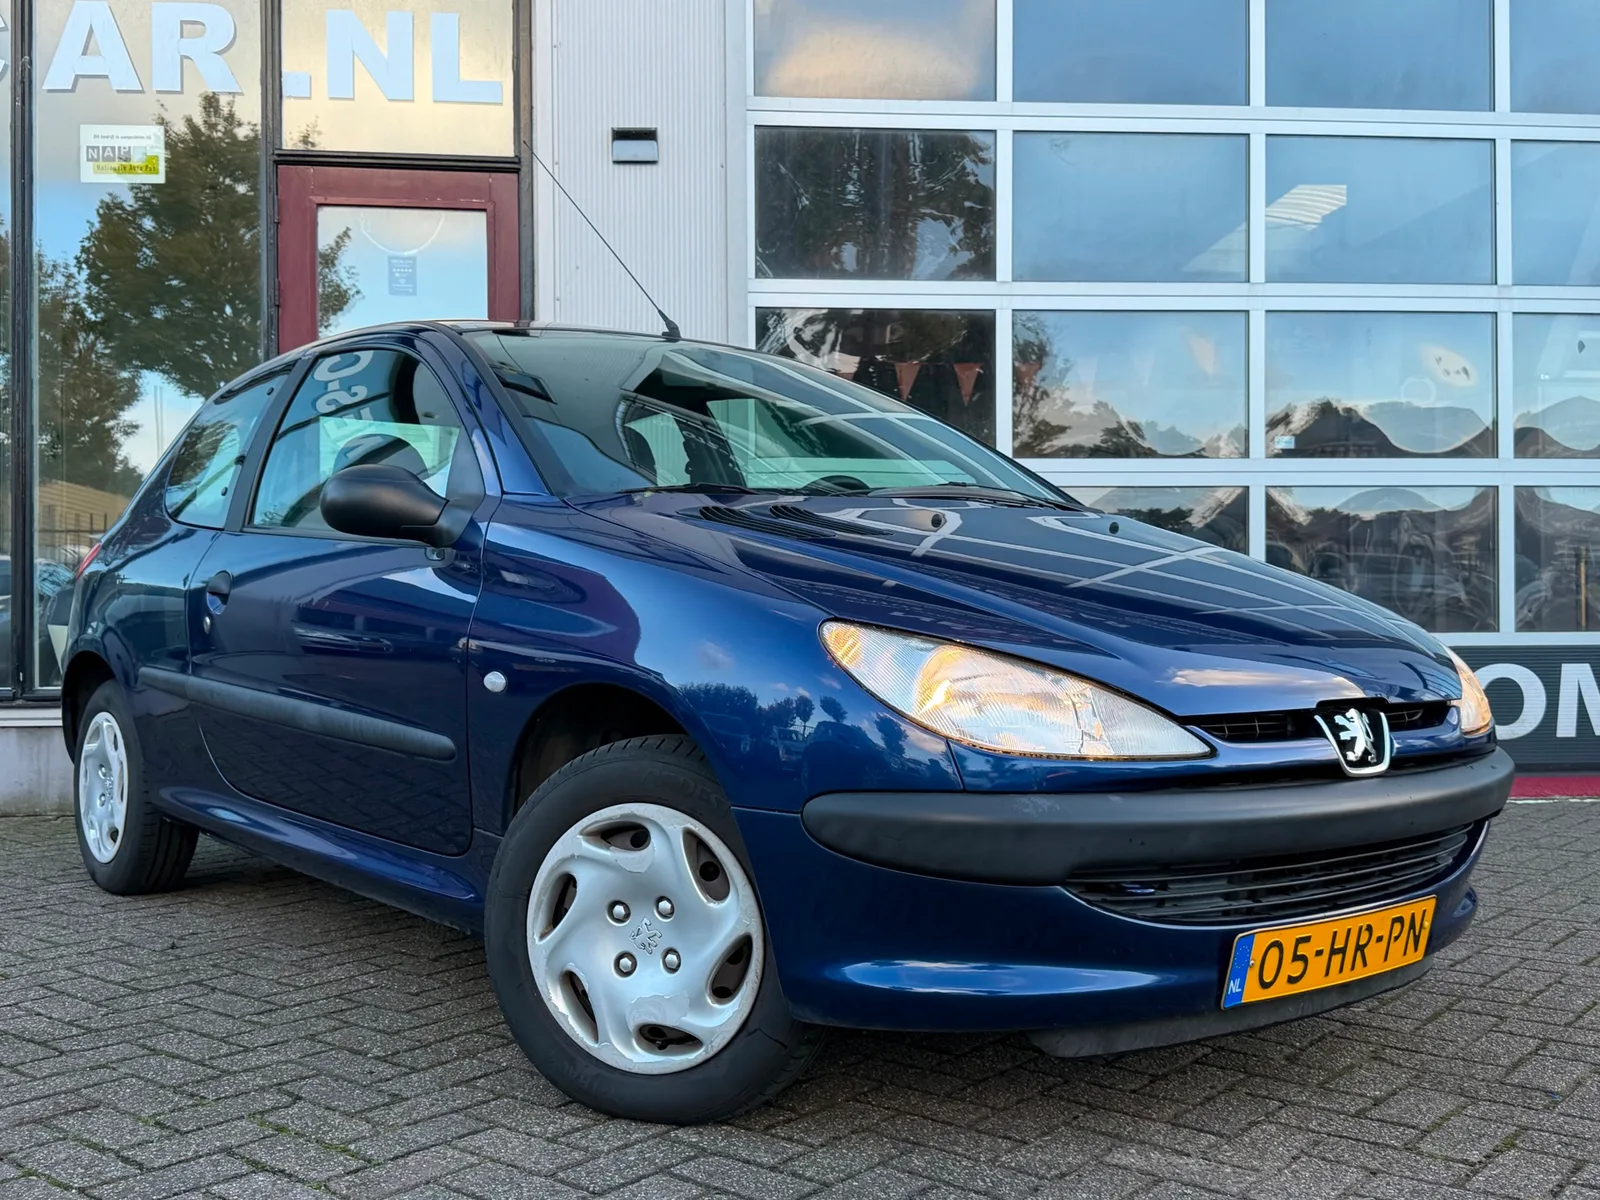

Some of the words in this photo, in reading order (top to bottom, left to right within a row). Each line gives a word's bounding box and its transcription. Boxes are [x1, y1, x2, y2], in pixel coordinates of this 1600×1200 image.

[88, 146, 129, 159] NAP
[145, 164, 156, 172] Pas
[1258, 909, 1427, 989] 05-HR-PN
[1228, 977, 1242, 994] NL
